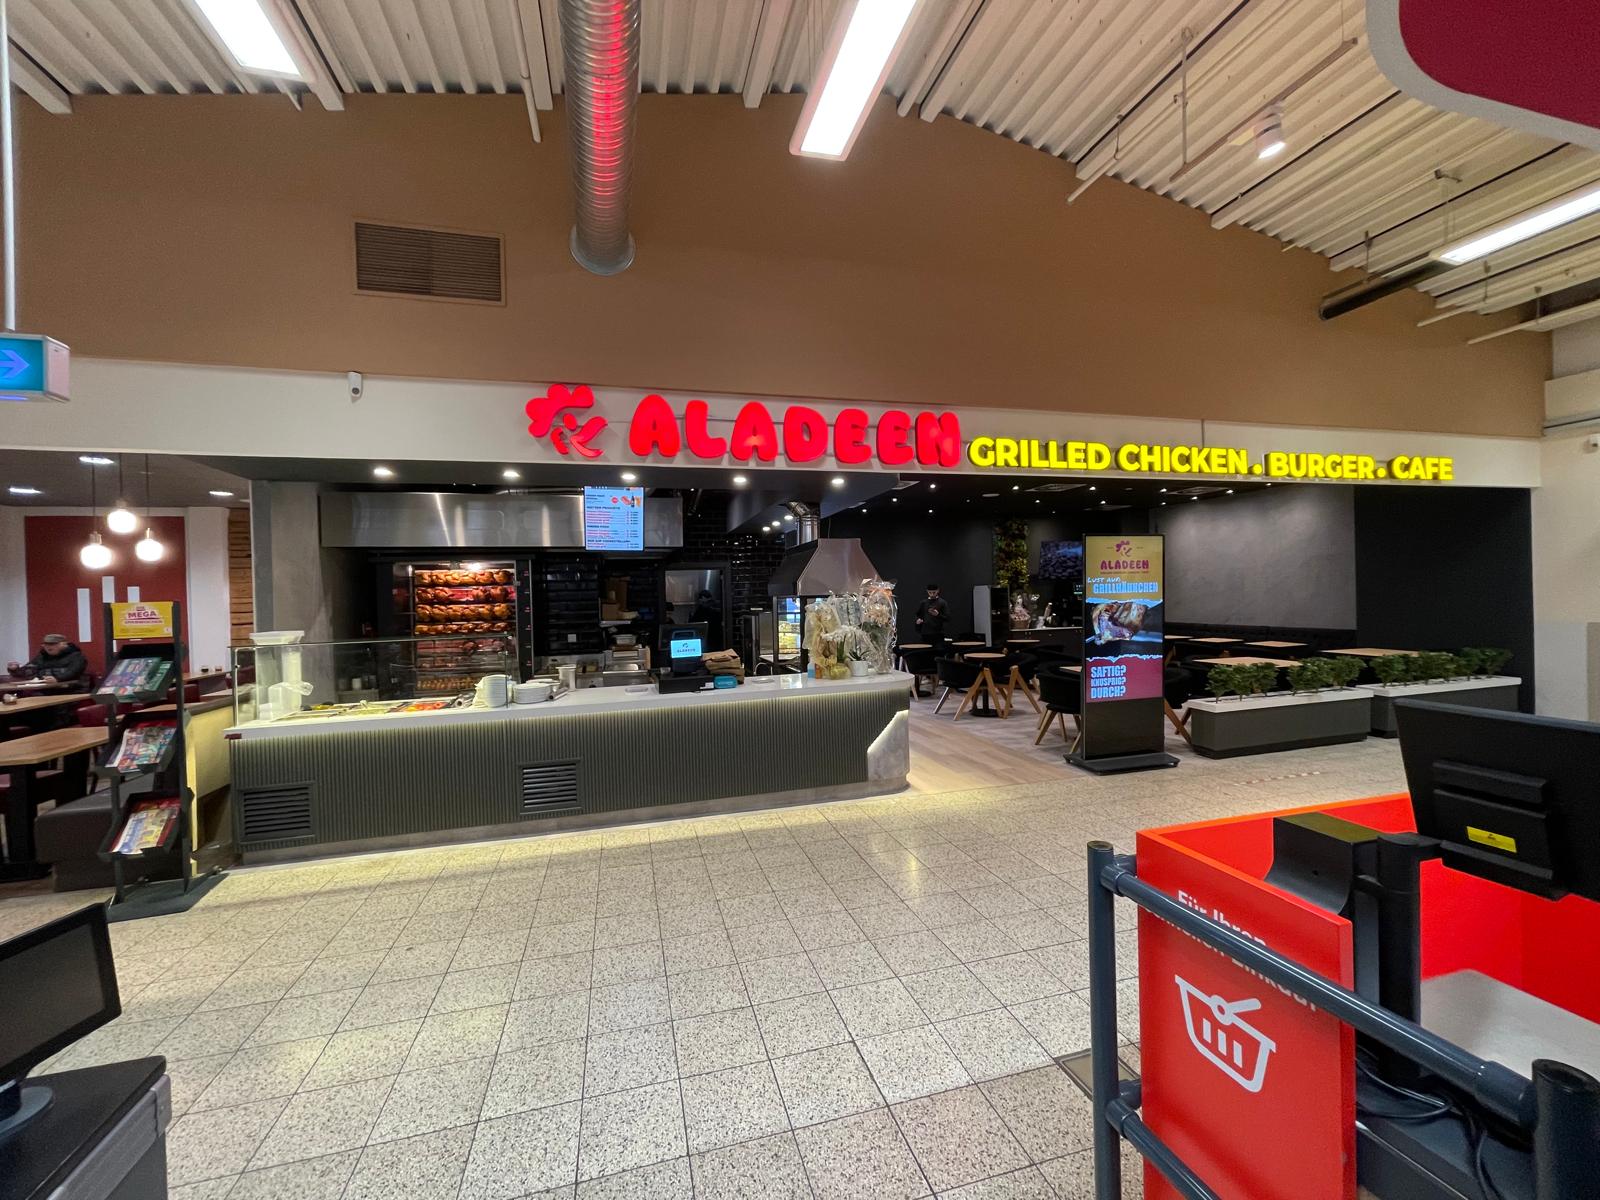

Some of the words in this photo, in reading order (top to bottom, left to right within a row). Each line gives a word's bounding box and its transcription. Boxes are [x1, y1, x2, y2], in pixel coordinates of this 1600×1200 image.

[629, 394, 962, 467] ALADEEN
[968, 436, 1112, 471] GRILLED
[1390, 455, 1454, 481] CAFE
[1100, 559, 1149, 570] ALADEEN
[127, 610, 157, 619] MEGA
[1090, 664, 1127, 678] SAFTIG?
[1090, 676, 1127, 687] KNUSPRIG?
[1090, 685, 1126, 699] DURCH?
